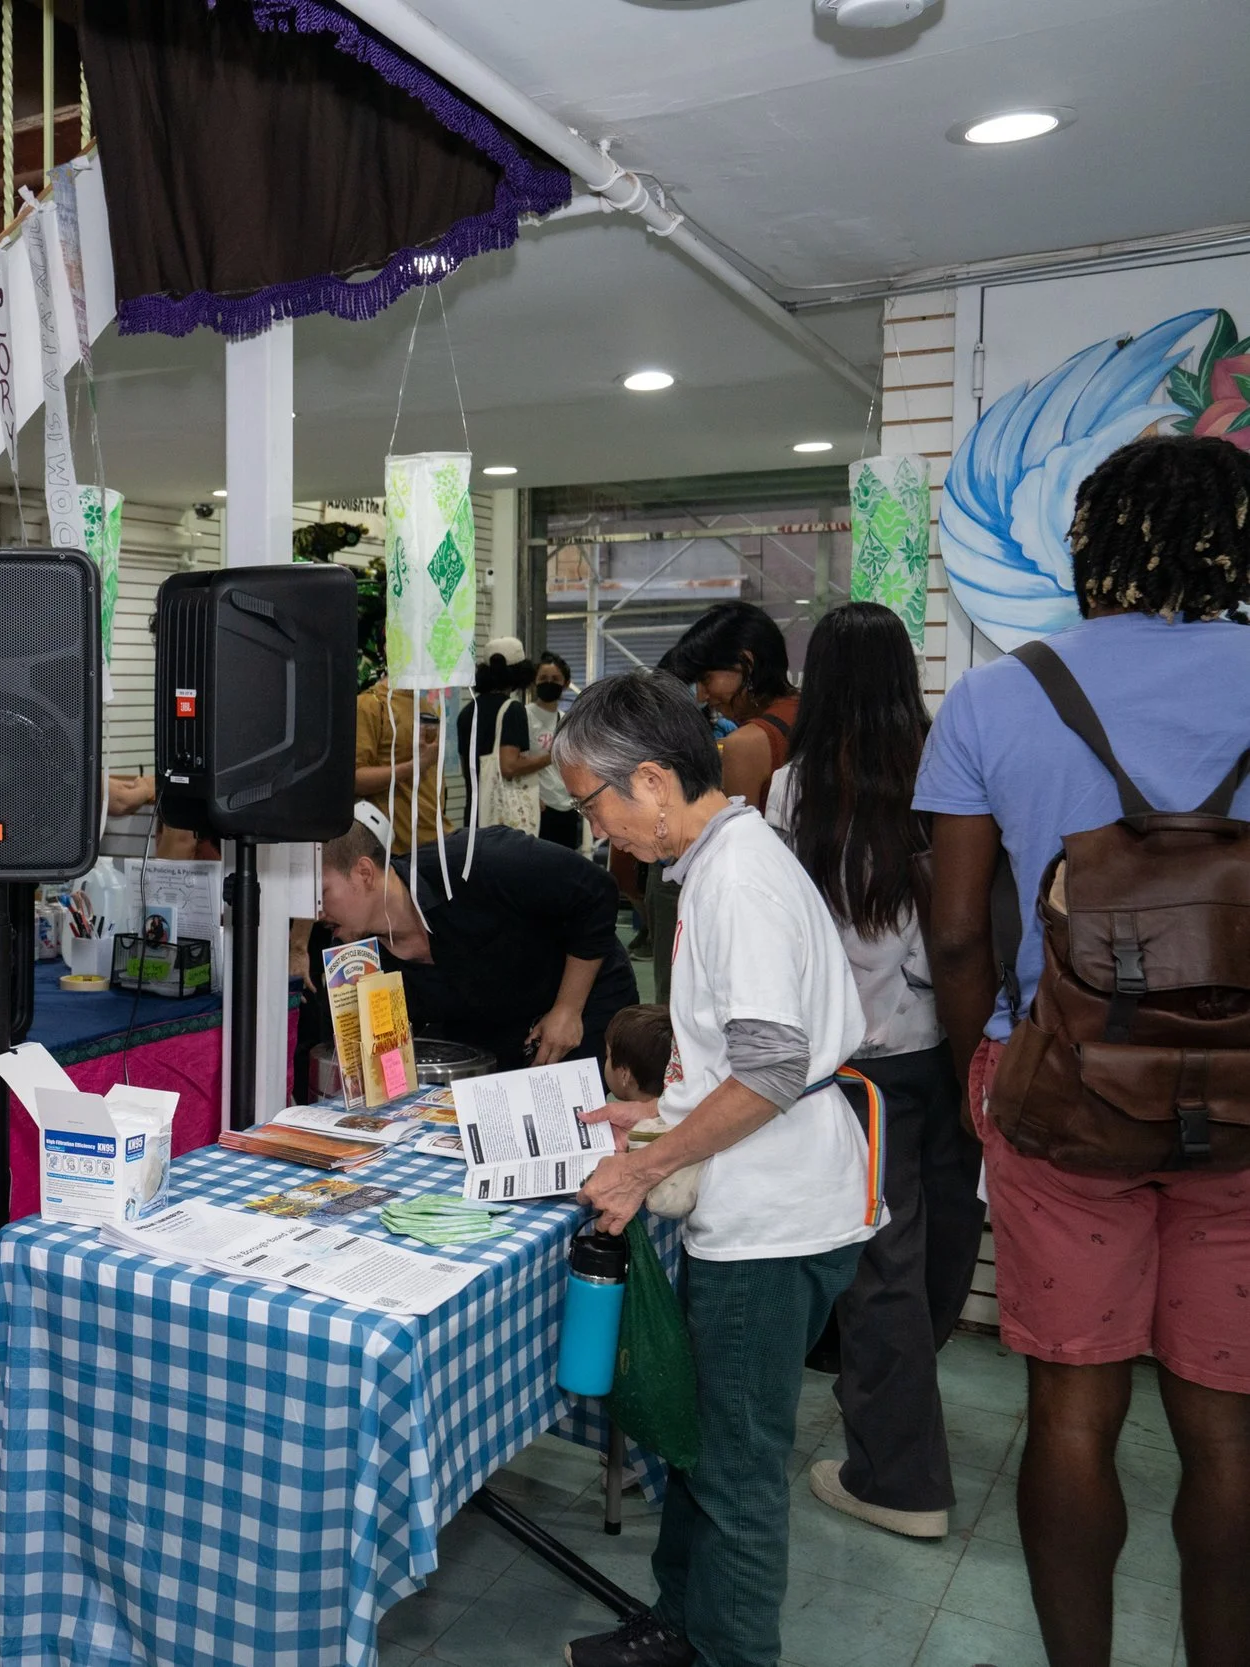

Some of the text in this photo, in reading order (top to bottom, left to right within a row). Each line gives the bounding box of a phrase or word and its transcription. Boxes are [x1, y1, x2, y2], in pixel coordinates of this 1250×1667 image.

[327, 499, 379, 514] Abolish the
[180, 702, 192, 711] JBL
[46, 1138, 96, 1151] High Filtration Efficiency
[97, 1142, 115, 1153] KN95
[127, 1136, 143, 1152] KN95
[227, 1253, 244, 1261] The
